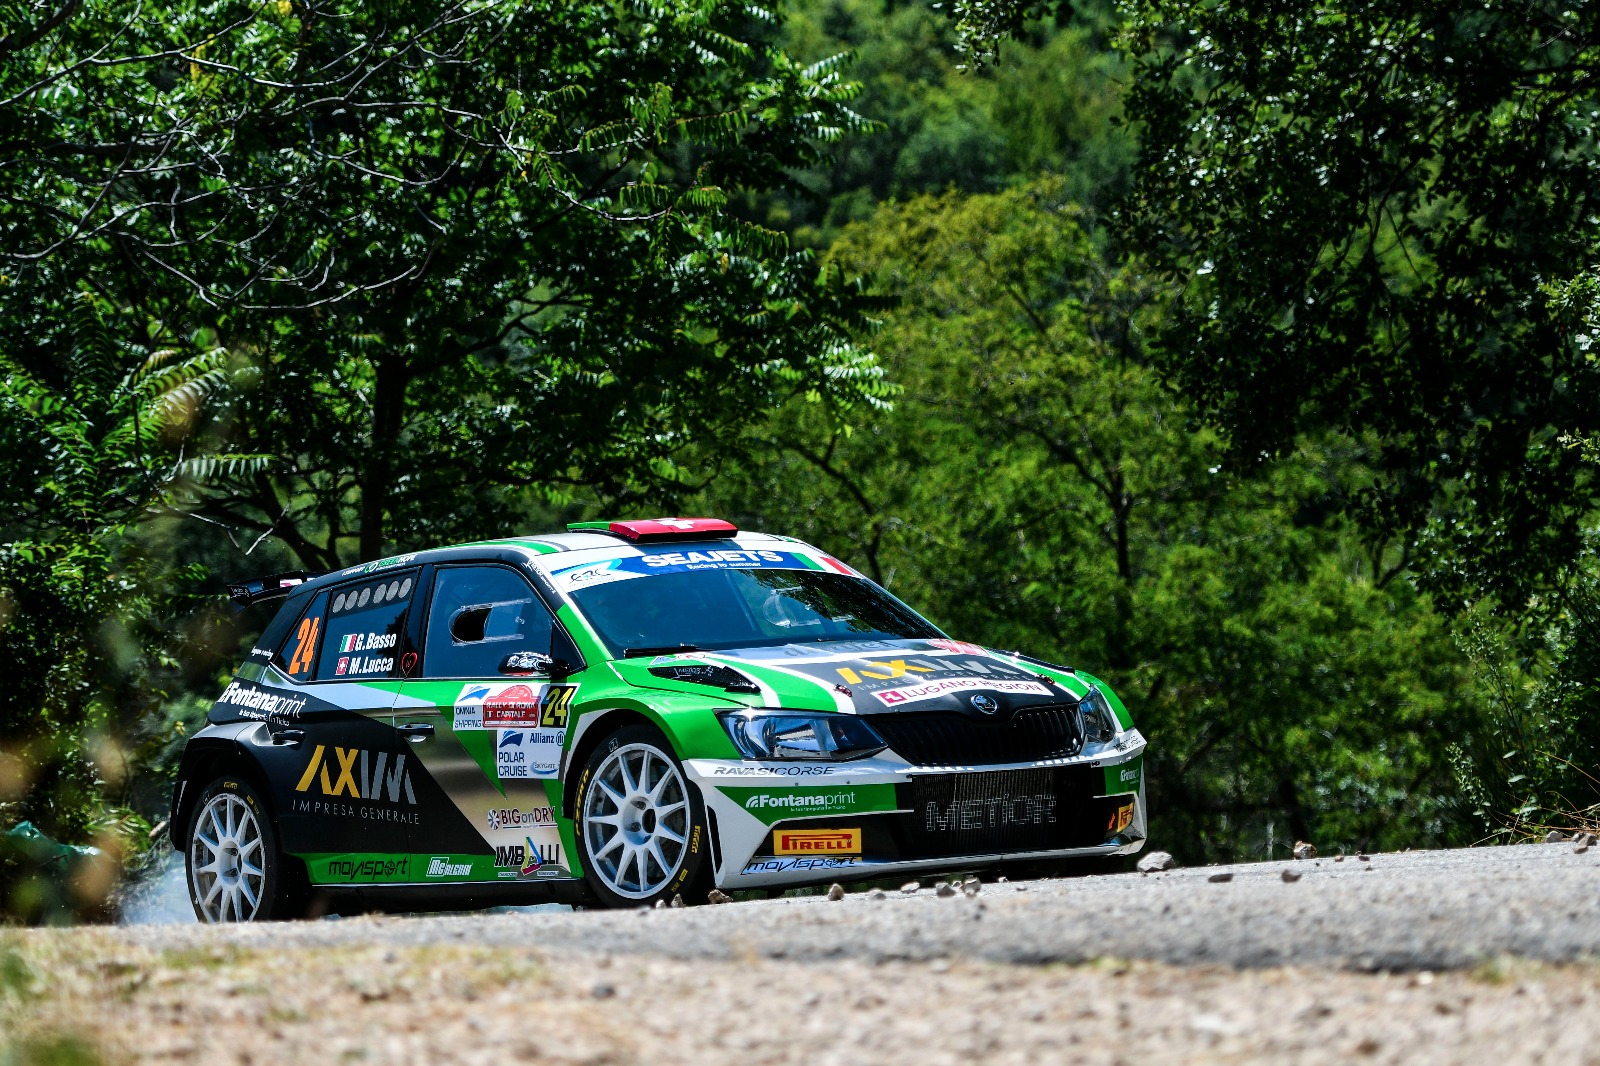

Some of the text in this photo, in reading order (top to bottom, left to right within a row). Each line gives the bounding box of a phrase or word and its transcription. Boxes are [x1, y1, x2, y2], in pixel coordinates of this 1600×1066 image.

[641, 550, 784, 568] SEAJETS
[288, 616, 320, 675] 24
[354, 632, 397, 651] G.Basso
[349, 656, 394, 675] M.Lucca
[903, 678, 1044, 698] LUGANO REGION
[224, 681, 307, 719] Fontanaprint
[542, 687, 574, 726] 24
[529, 732, 555, 744] Allianz
[498, 751, 525, 763] POLAR
[498, 765, 528, 777] CRUISE
[758, 791, 856, 810] Fontanaprint
[292, 799, 420, 825] IMPRESA GENERALE
[781, 833, 853, 851] PIRELLI
